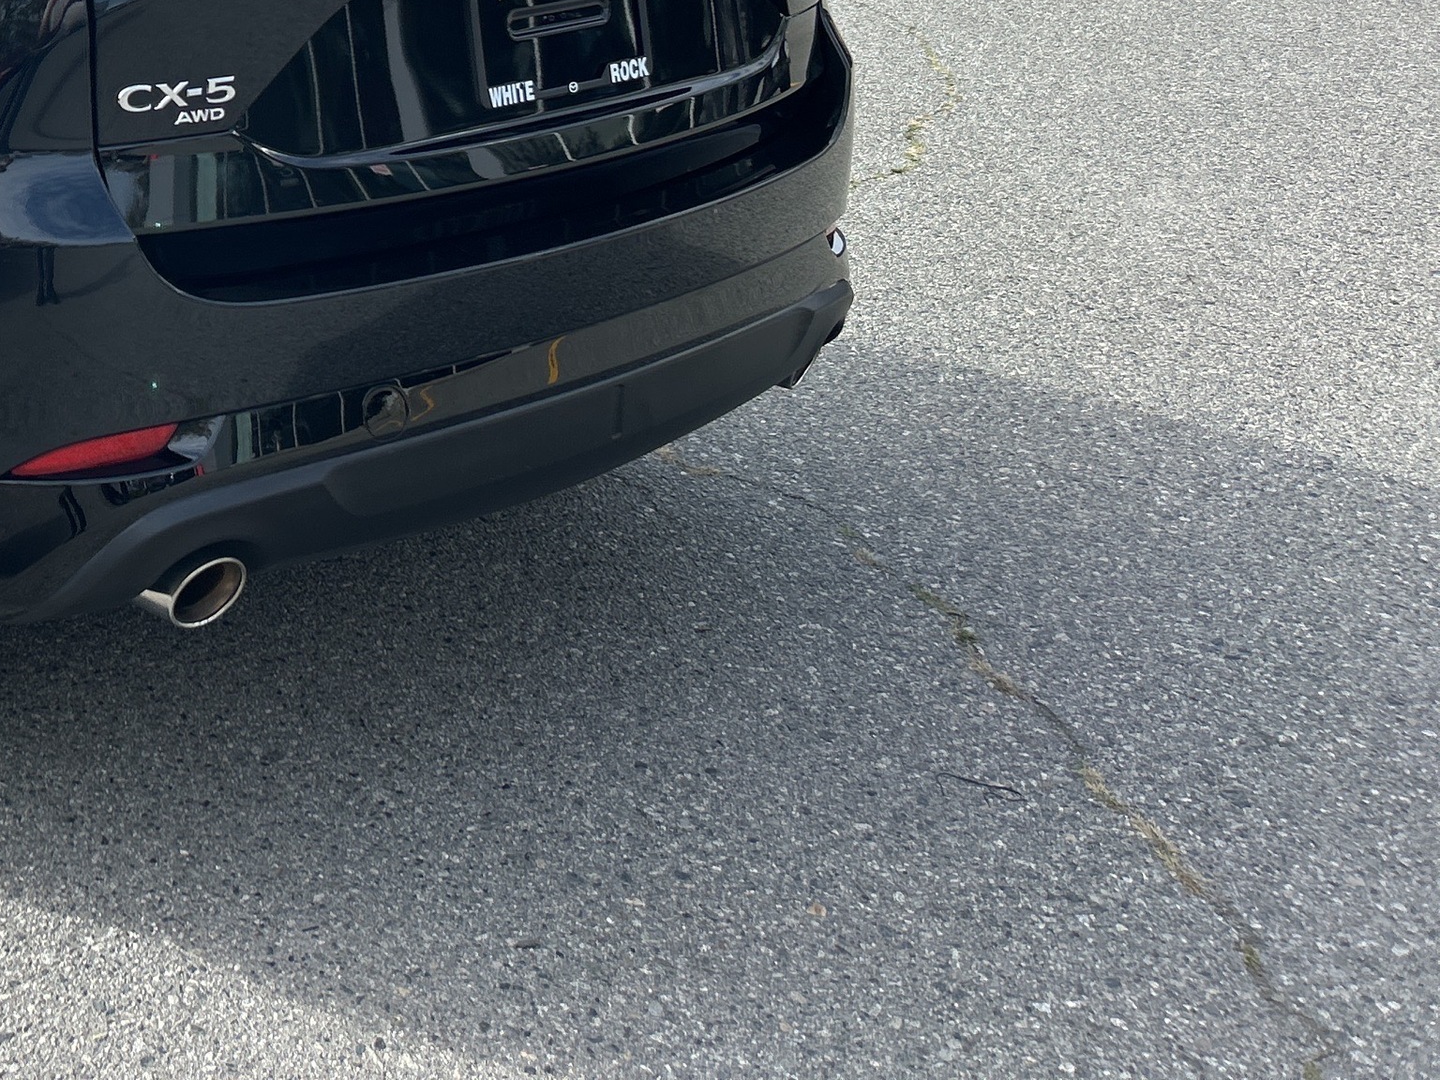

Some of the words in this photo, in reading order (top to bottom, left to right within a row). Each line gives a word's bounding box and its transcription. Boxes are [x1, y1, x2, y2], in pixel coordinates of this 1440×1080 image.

[117, 75, 236, 113] CX-5
[488, 80, 535, 108] WHITE
[610, 56, 650, 84] ROCK
[174, 107, 225, 126] AWD
